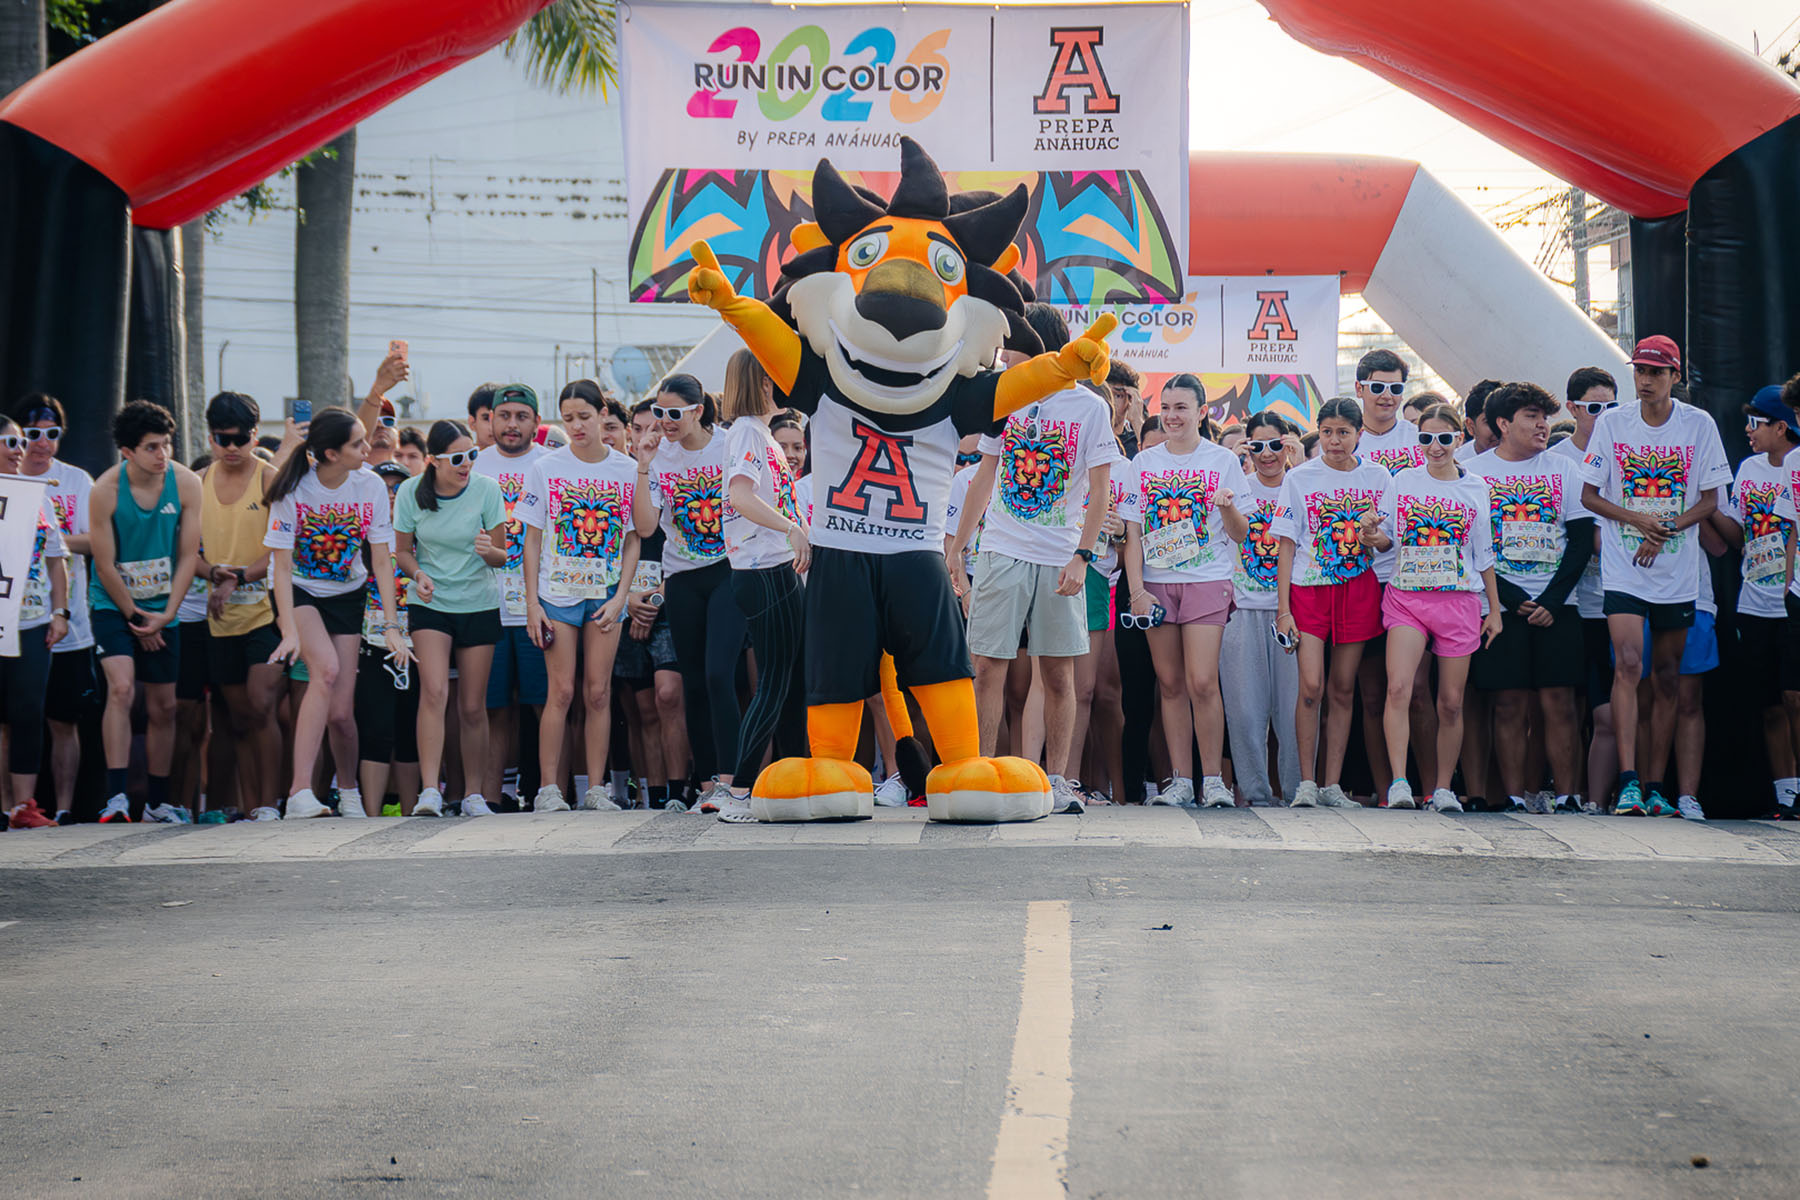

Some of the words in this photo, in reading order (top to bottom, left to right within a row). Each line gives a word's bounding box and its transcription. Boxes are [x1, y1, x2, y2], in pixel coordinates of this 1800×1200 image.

[687, 25, 951, 122] 2026
[695, 63, 766, 91] RUN
[778, 63, 810, 91] IN
[821, 63, 944, 92] COLOR
[1033, 26, 1120, 114] A
[1039, 119, 1114, 134] PREPA
[767, 131, 816, 147] PREPA
[825, 127, 901, 148] ANÁHUAC
[1033, 133, 1119, 151] ANÁHUAC
[1061, 309, 1088, 324] UN
[1122, 311, 1194, 326] COLOR
[1247, 290, 1298, 340] A
[1124, 346, 1169, 359] ANÁHUAC
[1250, 343, 1294, 353] PREPA
[1247, 353, 1298, 364] ANÁHUAC
[826, 417, 928, 525] A
[826, 515, 925, 540] ANÁHUAC
[1514, 534, 1547, 550] 550
